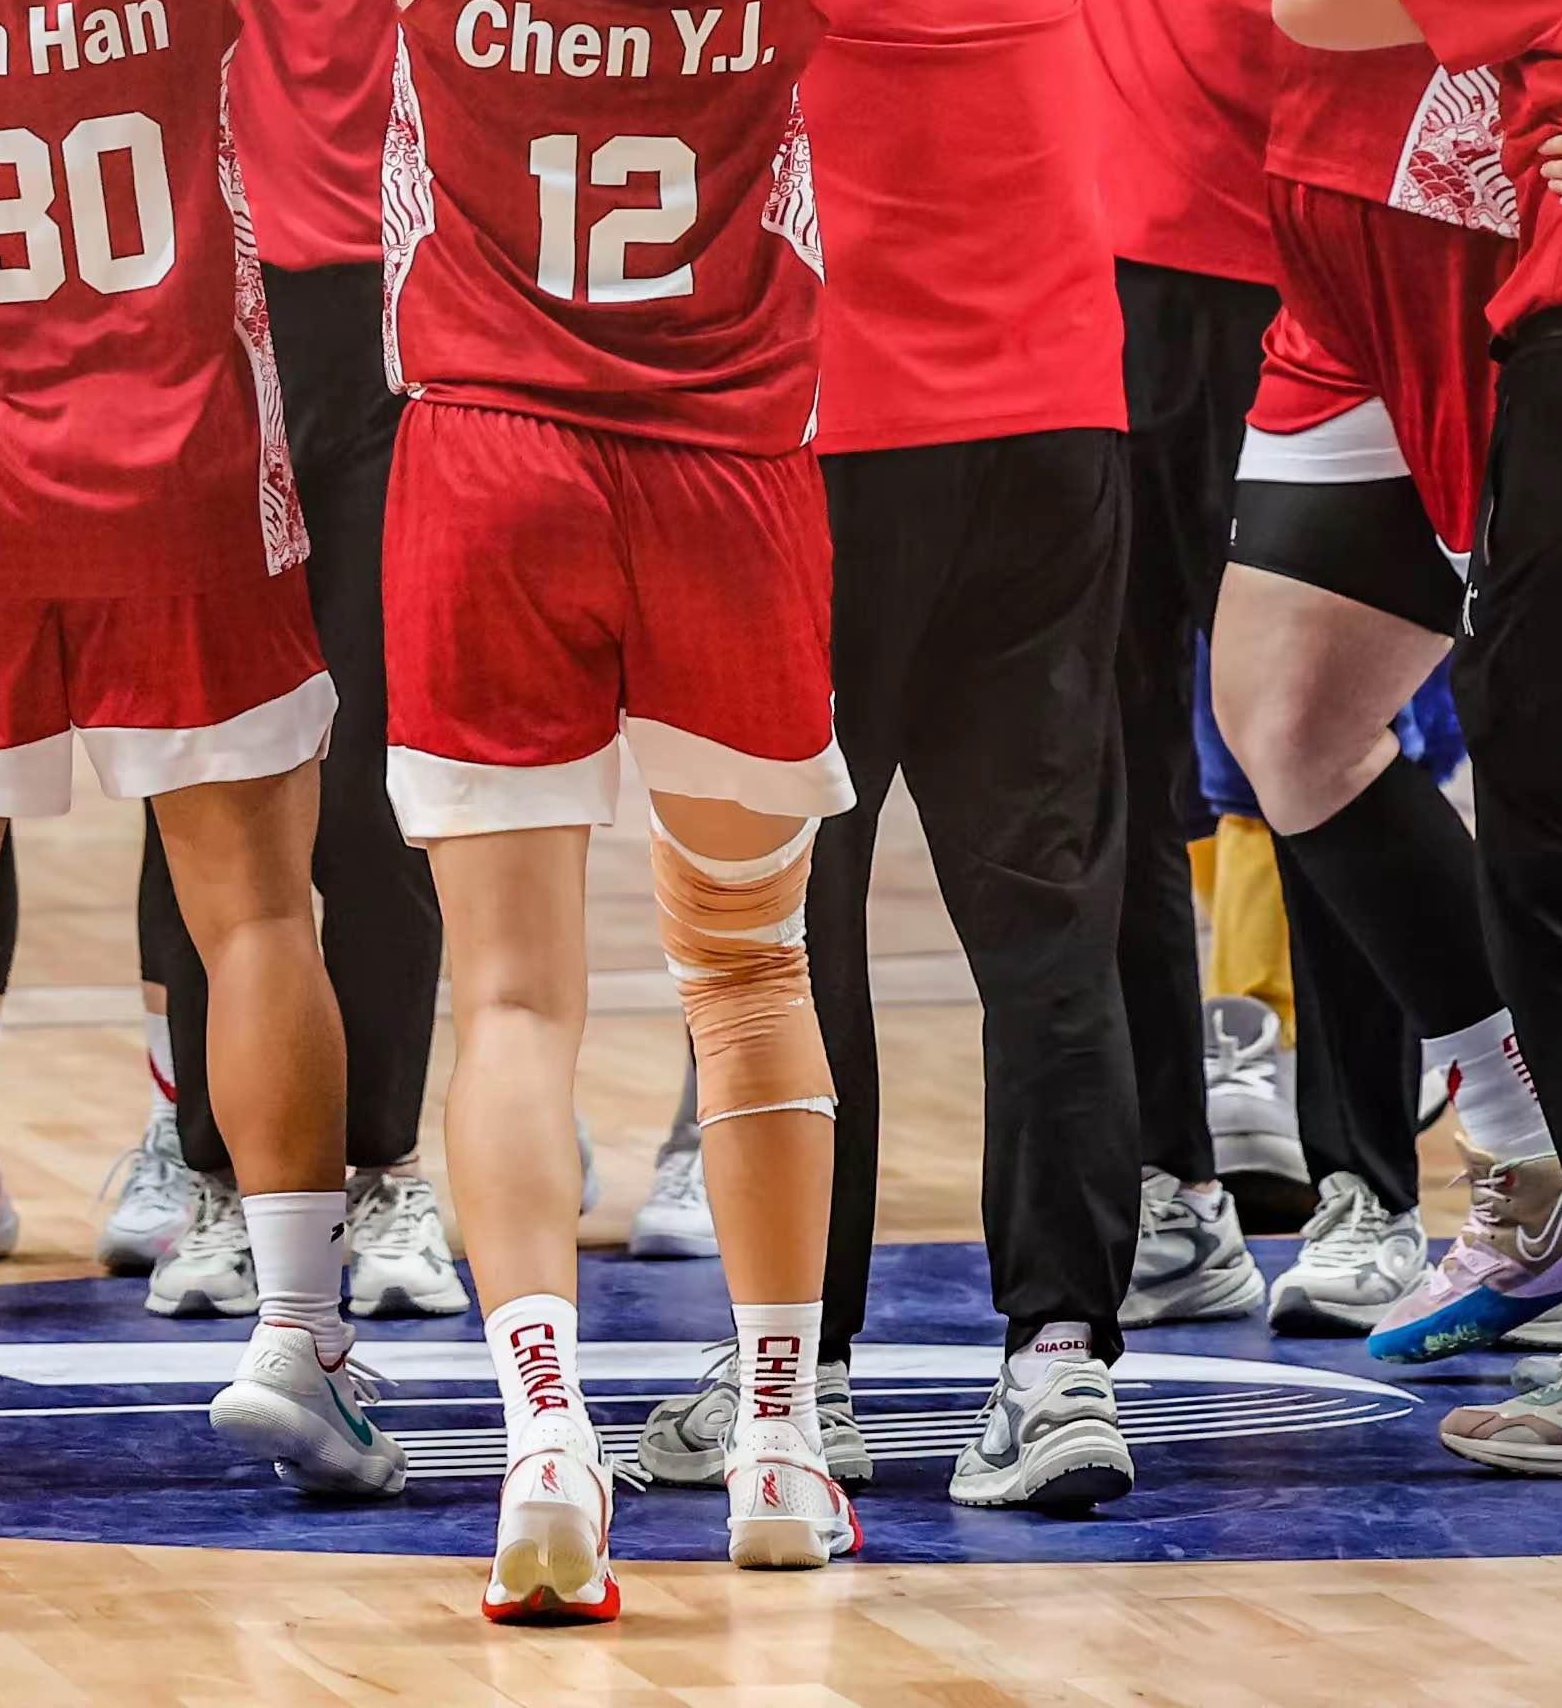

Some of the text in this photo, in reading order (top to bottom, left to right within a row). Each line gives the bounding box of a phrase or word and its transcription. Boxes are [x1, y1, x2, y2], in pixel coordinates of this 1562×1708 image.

[670, 0, 776, 76] Y.J.
[529, 133, 699, 304] 12
[510, 1323, 569, 1417] CHINA
[753, 1335, 801, 1420] CHINA
